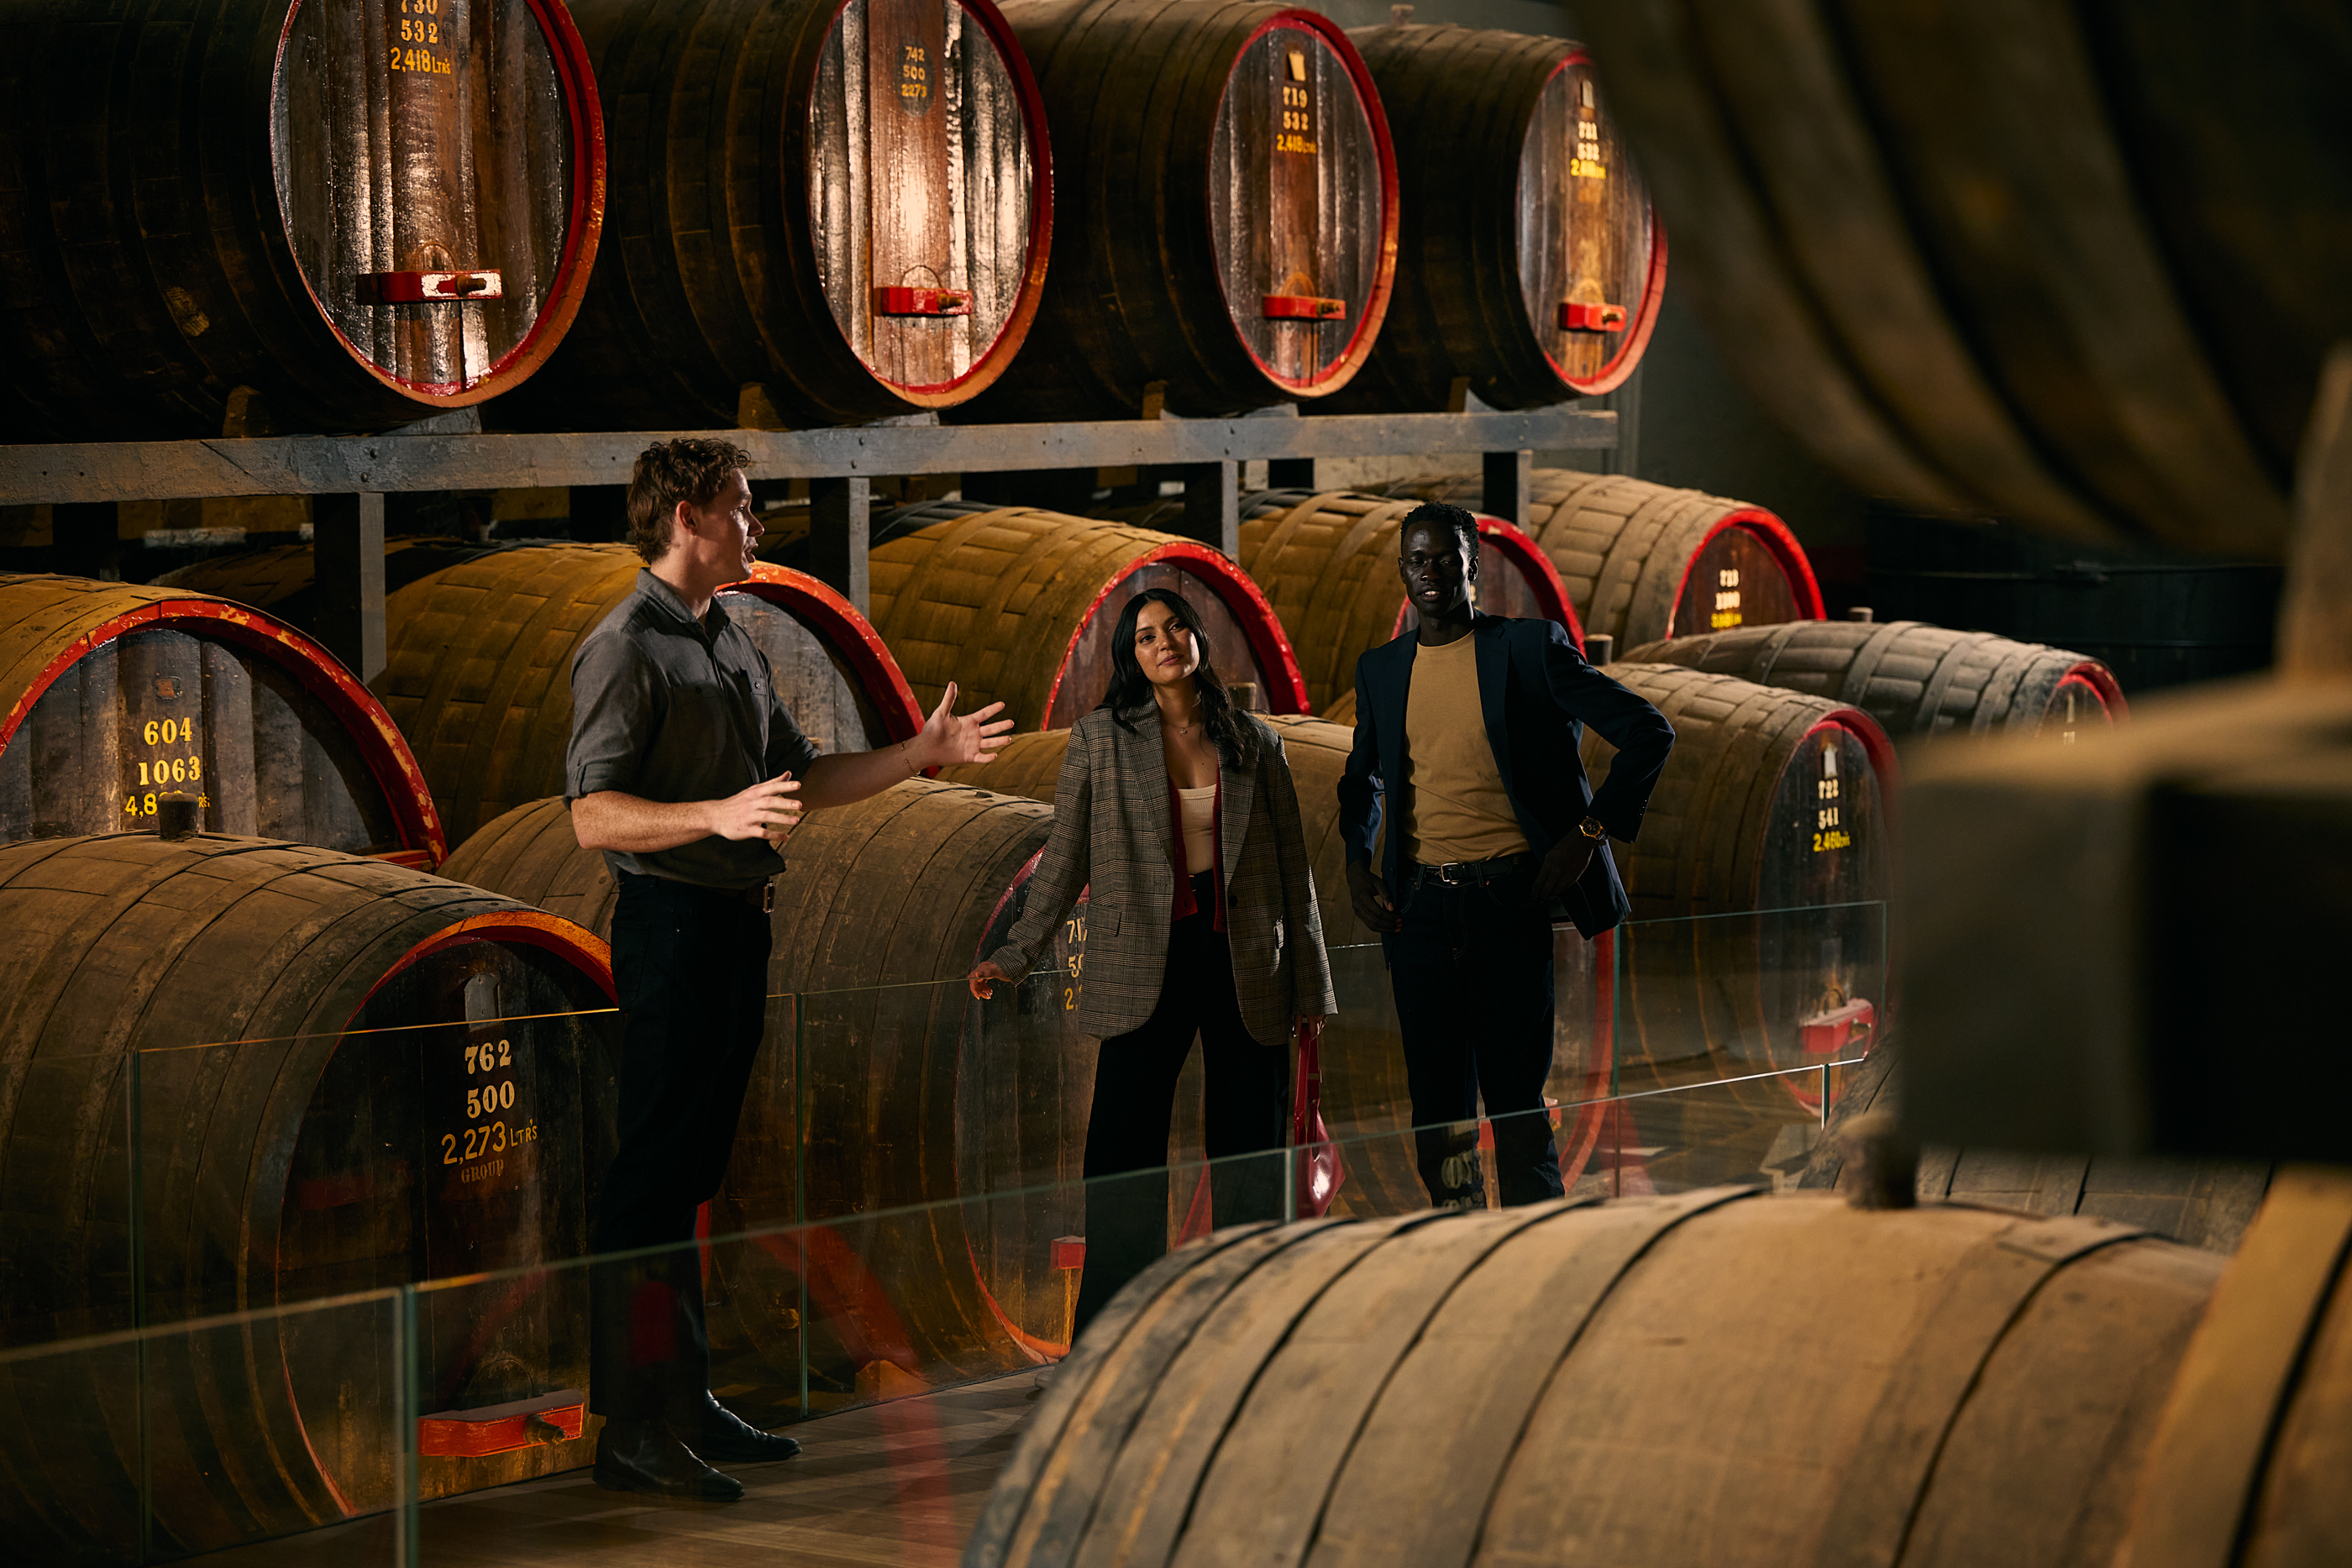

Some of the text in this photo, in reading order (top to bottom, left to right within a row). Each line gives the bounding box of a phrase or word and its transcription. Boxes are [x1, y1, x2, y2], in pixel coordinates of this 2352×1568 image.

[401, 18, 438, 44] 532
[390, 46, 432, 73] 2,418
[905, 45, 926, 63] 742
[902, 64, 926, 81] 500
[900, 82, 927, 98] 2273
[1283, 86, 1308, 108] 719
[1283, 110, 1309, 131] 532
[144, 716, 192, 746] 604
[138, 755, 201, 786] 1063
[465, 1039, 512, 1075] 762
[466, 1080, 515, 1120] 500
[441, 1120, 507, 1166] 2,273
